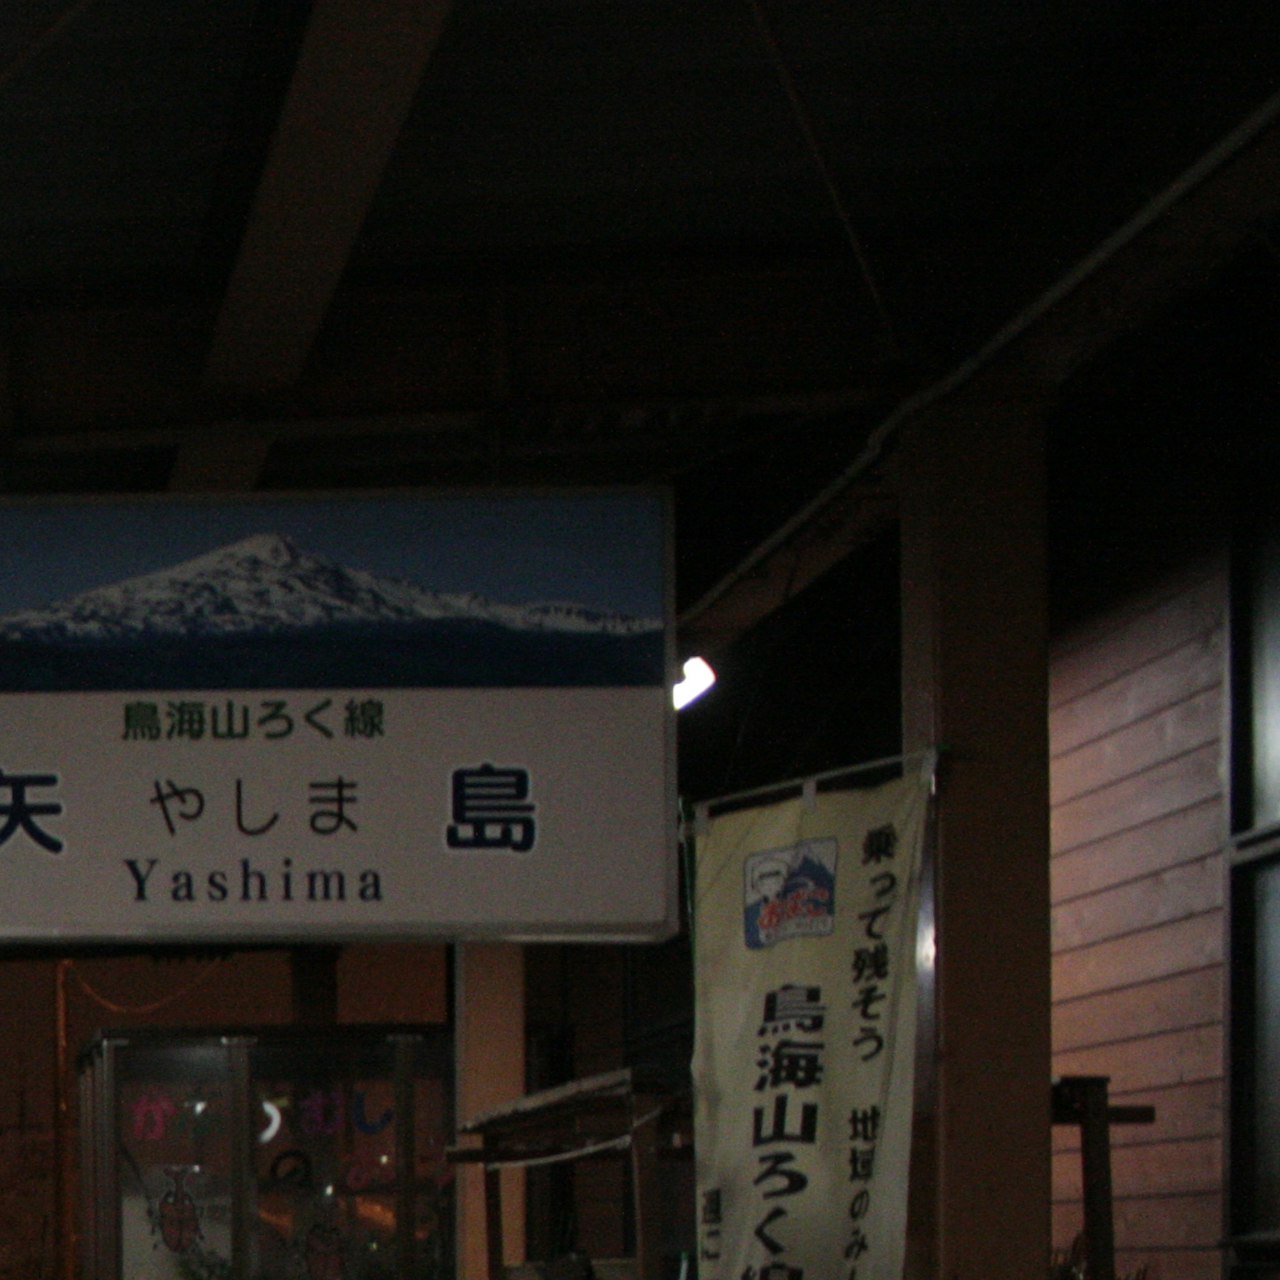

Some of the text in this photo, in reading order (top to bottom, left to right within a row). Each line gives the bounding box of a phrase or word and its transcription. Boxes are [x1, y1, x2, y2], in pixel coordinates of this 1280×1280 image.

[122, 698, 386, 741] 鳥海山ろく線
[149, 775, 360, 838] やしま
[445, 762, 537, 853] 島
[123, 858, 384, 902] Yashima
[850, 823, 898, 1063] 乗って残そう
